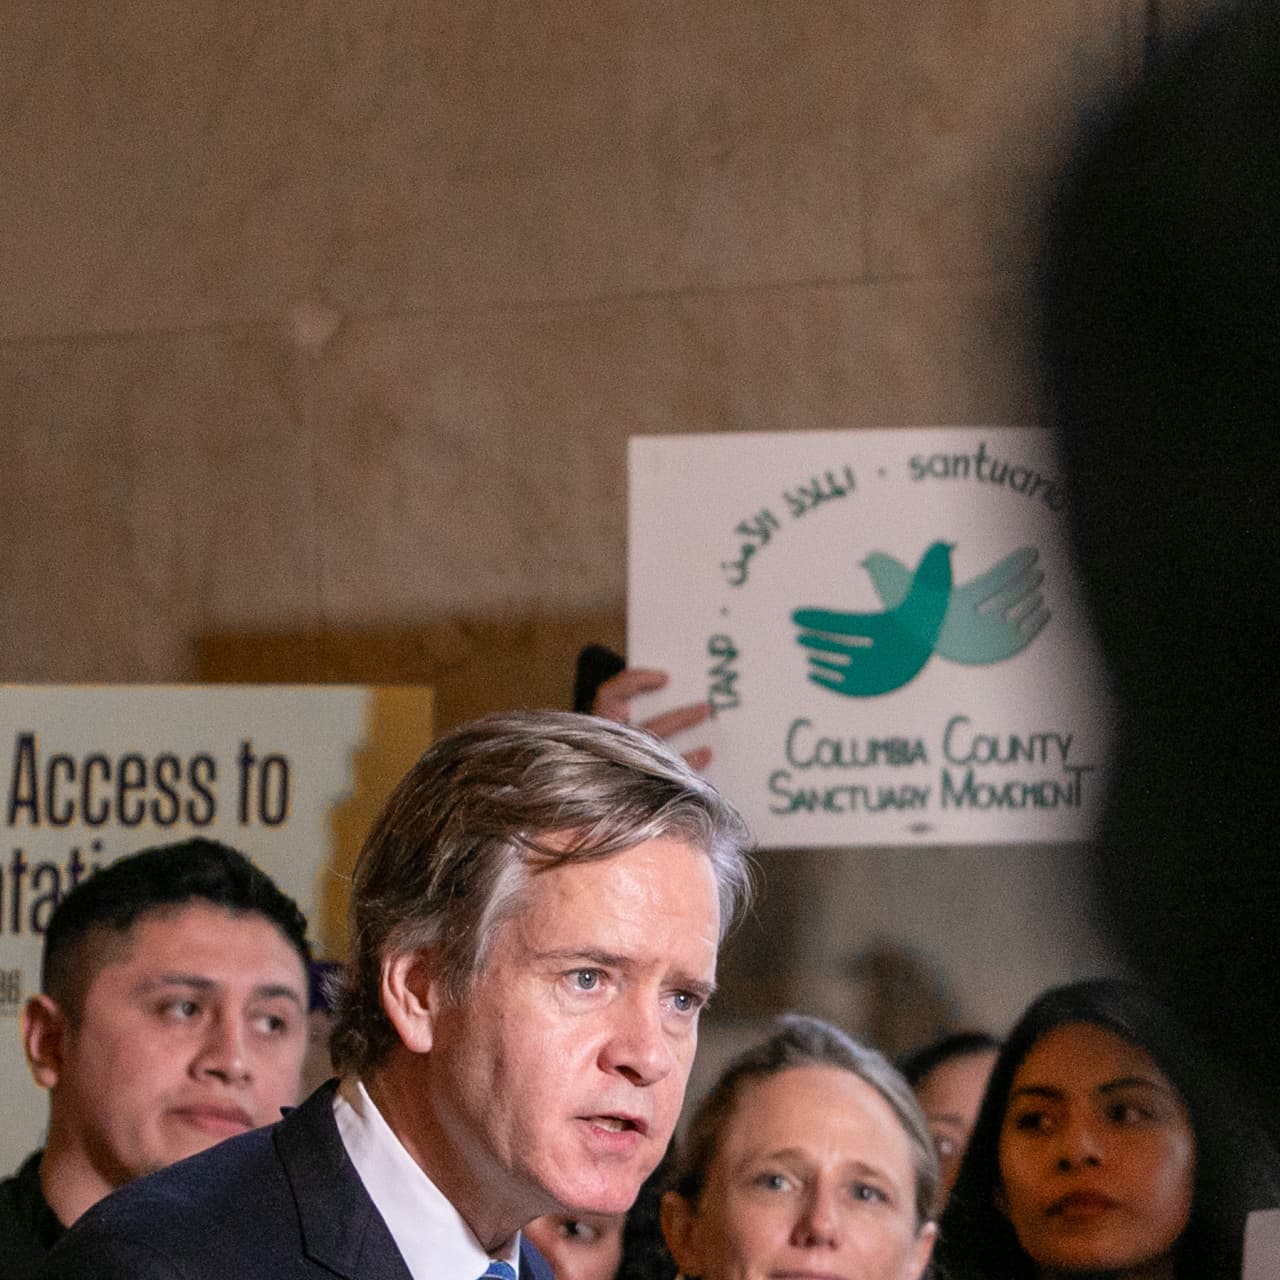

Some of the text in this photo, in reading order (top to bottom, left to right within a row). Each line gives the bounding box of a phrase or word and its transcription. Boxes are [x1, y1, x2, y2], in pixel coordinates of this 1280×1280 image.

[943, 714, 1074, 765] COUNTY
[8, 731, 217, 828] Access
[235, 739, 290, 828] to
[768, 764, 1098, 815] SANCTUARY MOVEMENT
